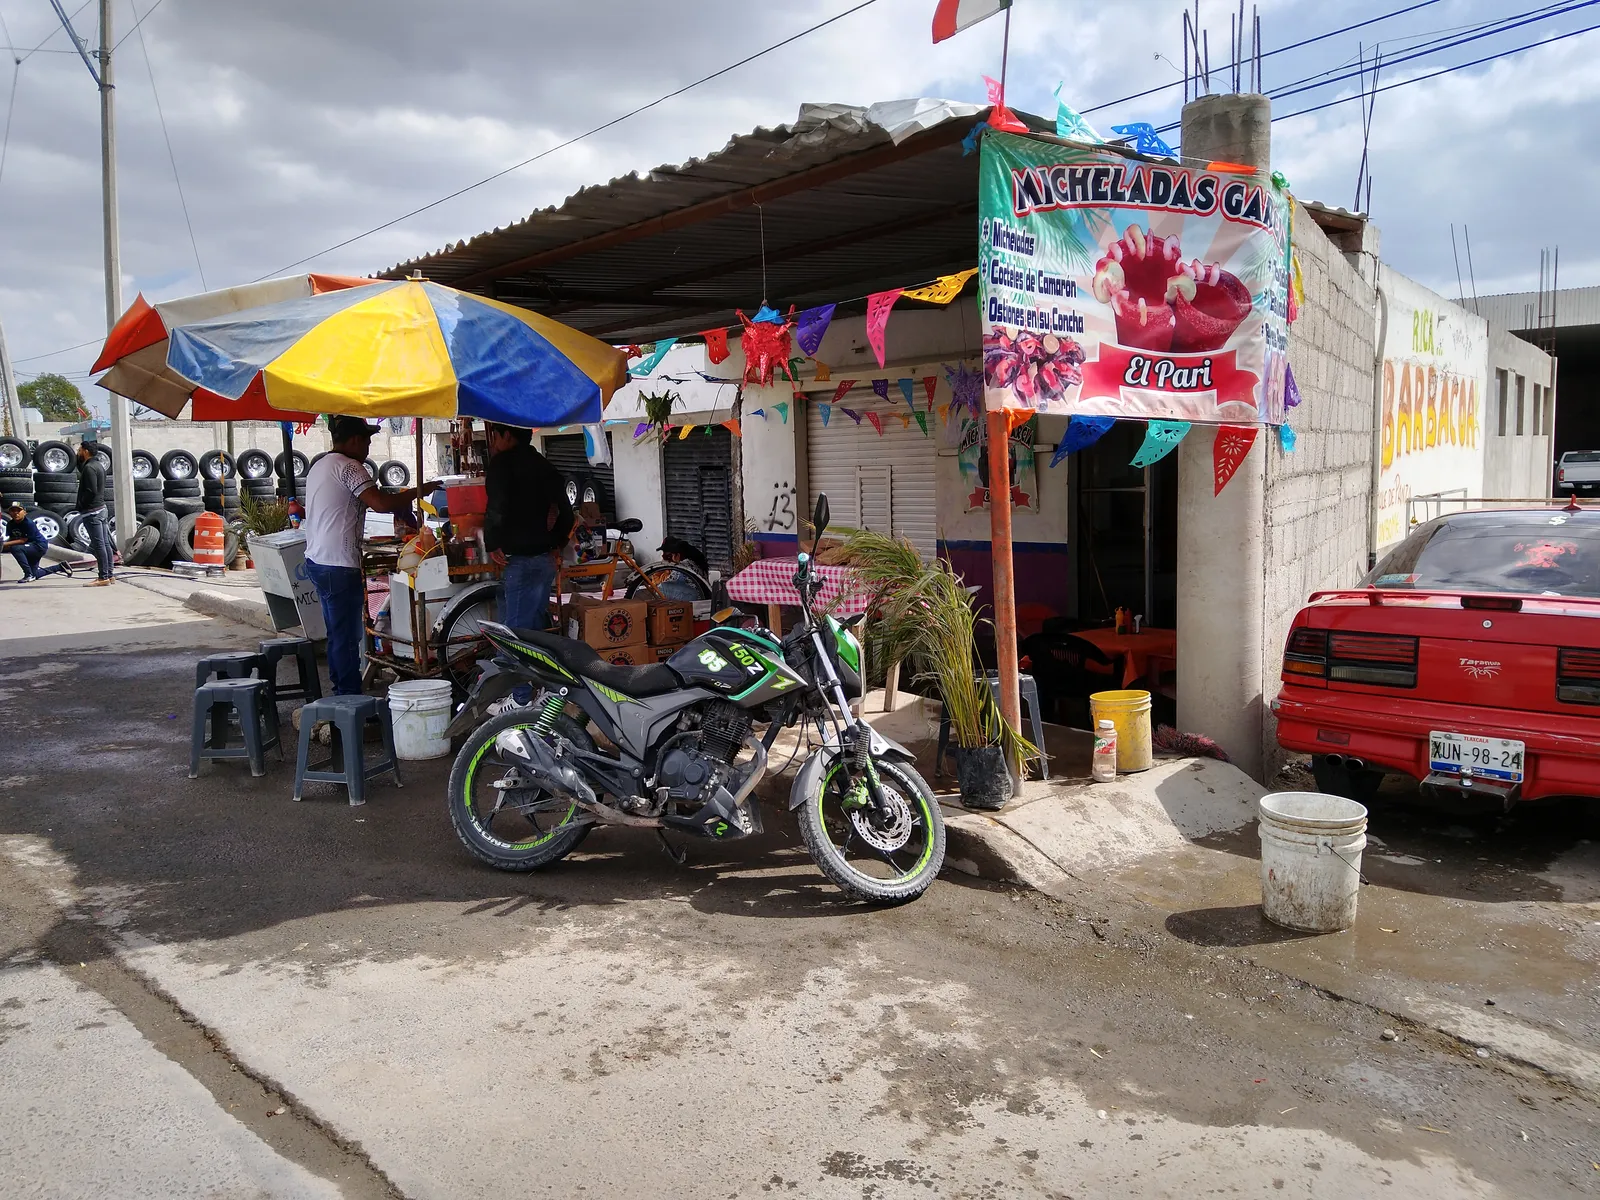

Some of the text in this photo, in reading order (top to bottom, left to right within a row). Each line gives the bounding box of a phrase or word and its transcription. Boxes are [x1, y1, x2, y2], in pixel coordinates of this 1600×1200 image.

[1013, 164, 1218, 217] MICHELADAS
[992, 220, 1035, 257] Micheladas
[990, 259, 1077, 298] Cocteles de Camarón
[988, 296, 1084, 333] Ostiones en su Concha
[1124, 356, 1212, 389] El Pari
[1380, 358, 1476, 477] BARBACOA
[729, 642, 765, 676] 150Z
[1433, 741, 1520, 769] XUN-98-24
